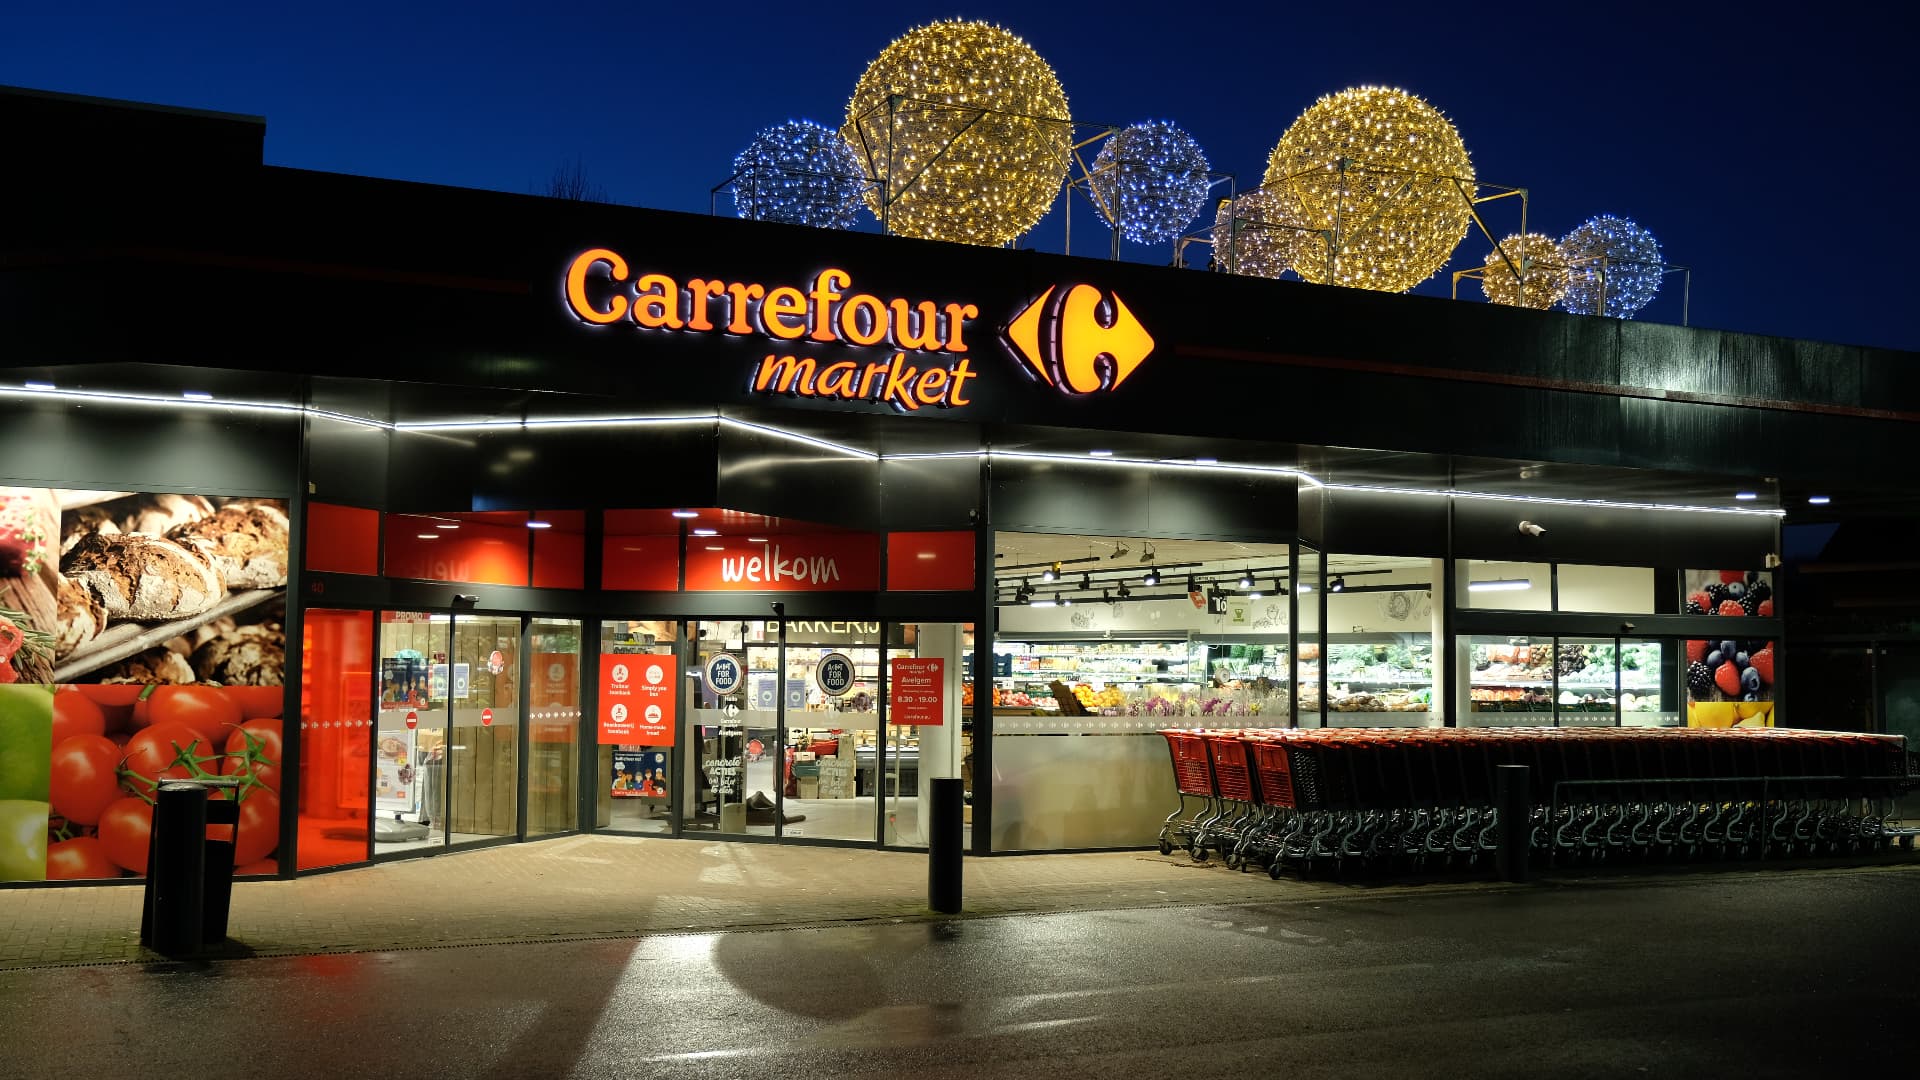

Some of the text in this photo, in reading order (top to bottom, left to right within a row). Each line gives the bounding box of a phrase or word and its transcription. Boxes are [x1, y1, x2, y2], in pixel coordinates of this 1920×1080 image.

[565, 248, 979, 352] Carrefour
[755, 352, 977, 410] market
[721, 543, 840, 585] welkom
[395, 611, 423, 620] PROMO
[717, 670, 730, 678] FOR
[828, 670, 842, 679] FOR
[715, 677, 733, 686] FOOD
[827, 678, 845, 686] FOOD
[901, 676, 932, 685] Avelgem
[897, 695, 913, 703] 8.30
[918, 695, 938, 703] 19.00
[718, 729, 743, 738] Avelgem
